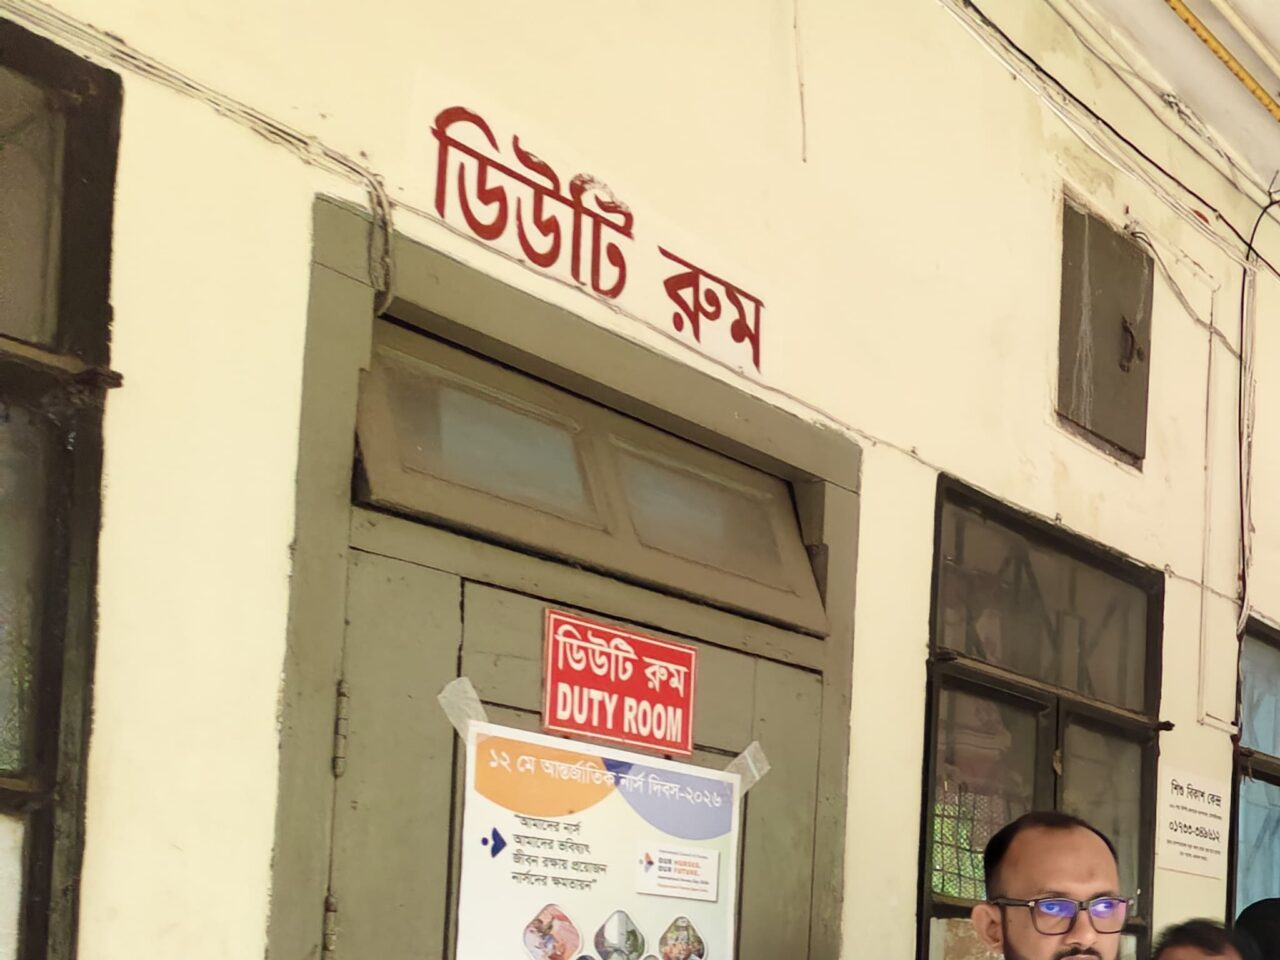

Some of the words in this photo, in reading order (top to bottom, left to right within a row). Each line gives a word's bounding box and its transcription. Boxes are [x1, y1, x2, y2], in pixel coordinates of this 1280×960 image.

[430, 105, 635, 299] ডিউটি
[657, 245, 765, 374] রুম
[554, 623, 640, 682] ডিউটি
[641, 656, 690, 698] রুম
[556, 681, 619, 730] DUTY
[623, 696, 683, 743] ROOM
[489, 748, 512, 772] ১২
[516, 754, 536, 774] মে
[539, 757, 618, 786] আন্তর্জাতিক
[618, 769, 646, 796] নার্স
[1186, 783, 1206, 804] বিকাশ
